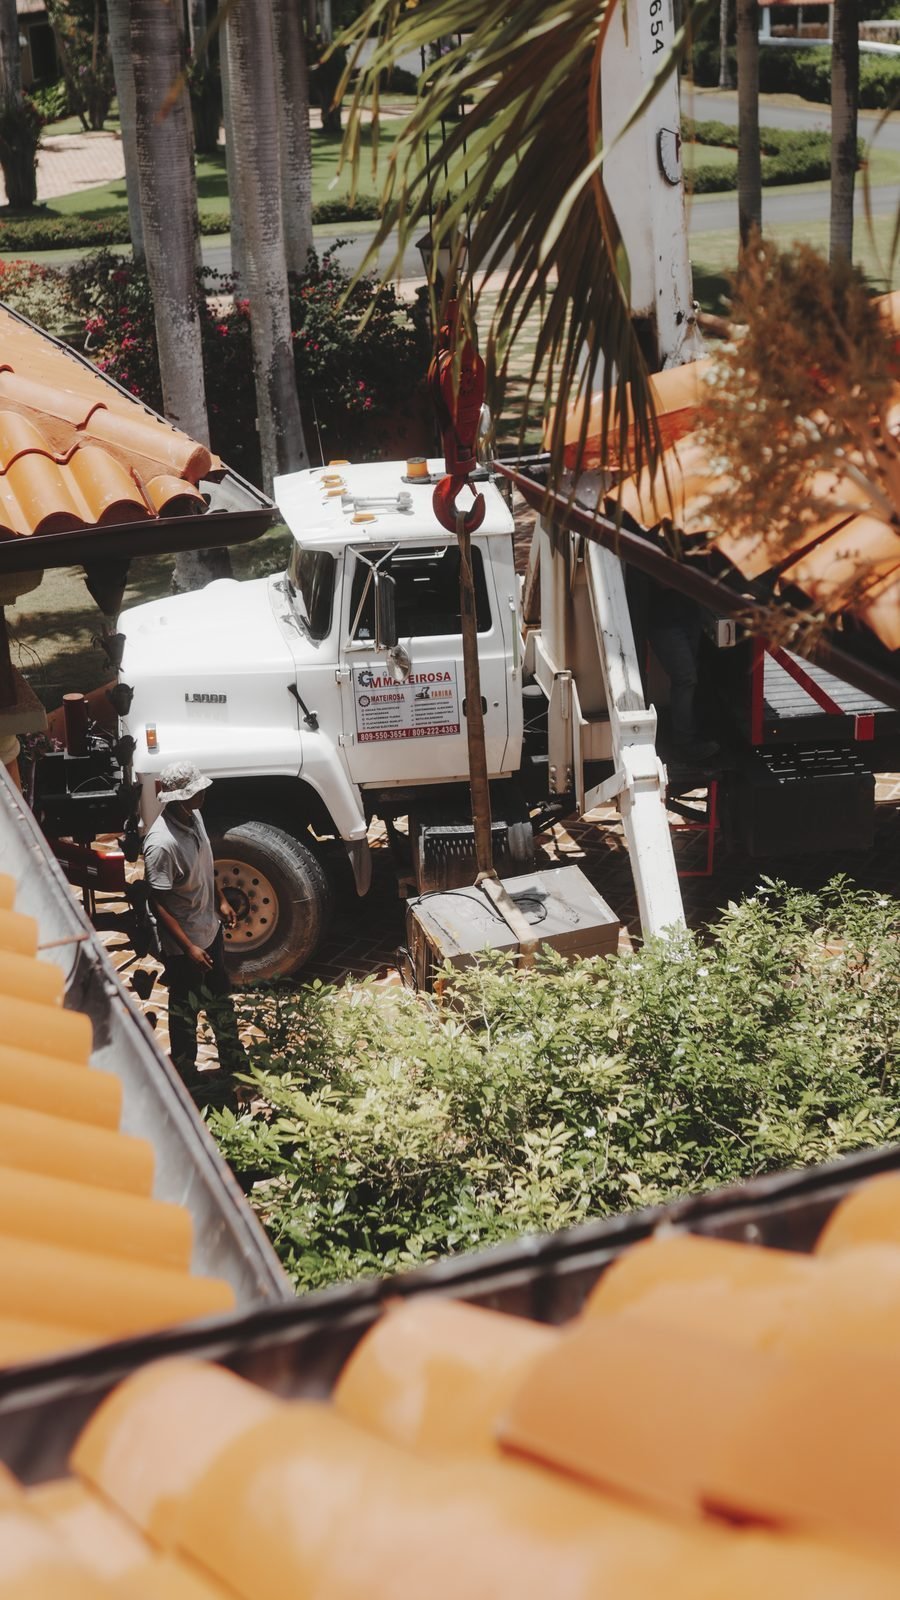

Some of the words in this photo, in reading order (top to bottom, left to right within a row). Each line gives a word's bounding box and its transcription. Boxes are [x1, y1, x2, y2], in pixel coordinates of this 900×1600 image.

[370, 693, 405, 702] MATEIROSA
[360, 730, 407, 741] 809-550-3654
[412, 725, 458, 736] 809-222-4363
